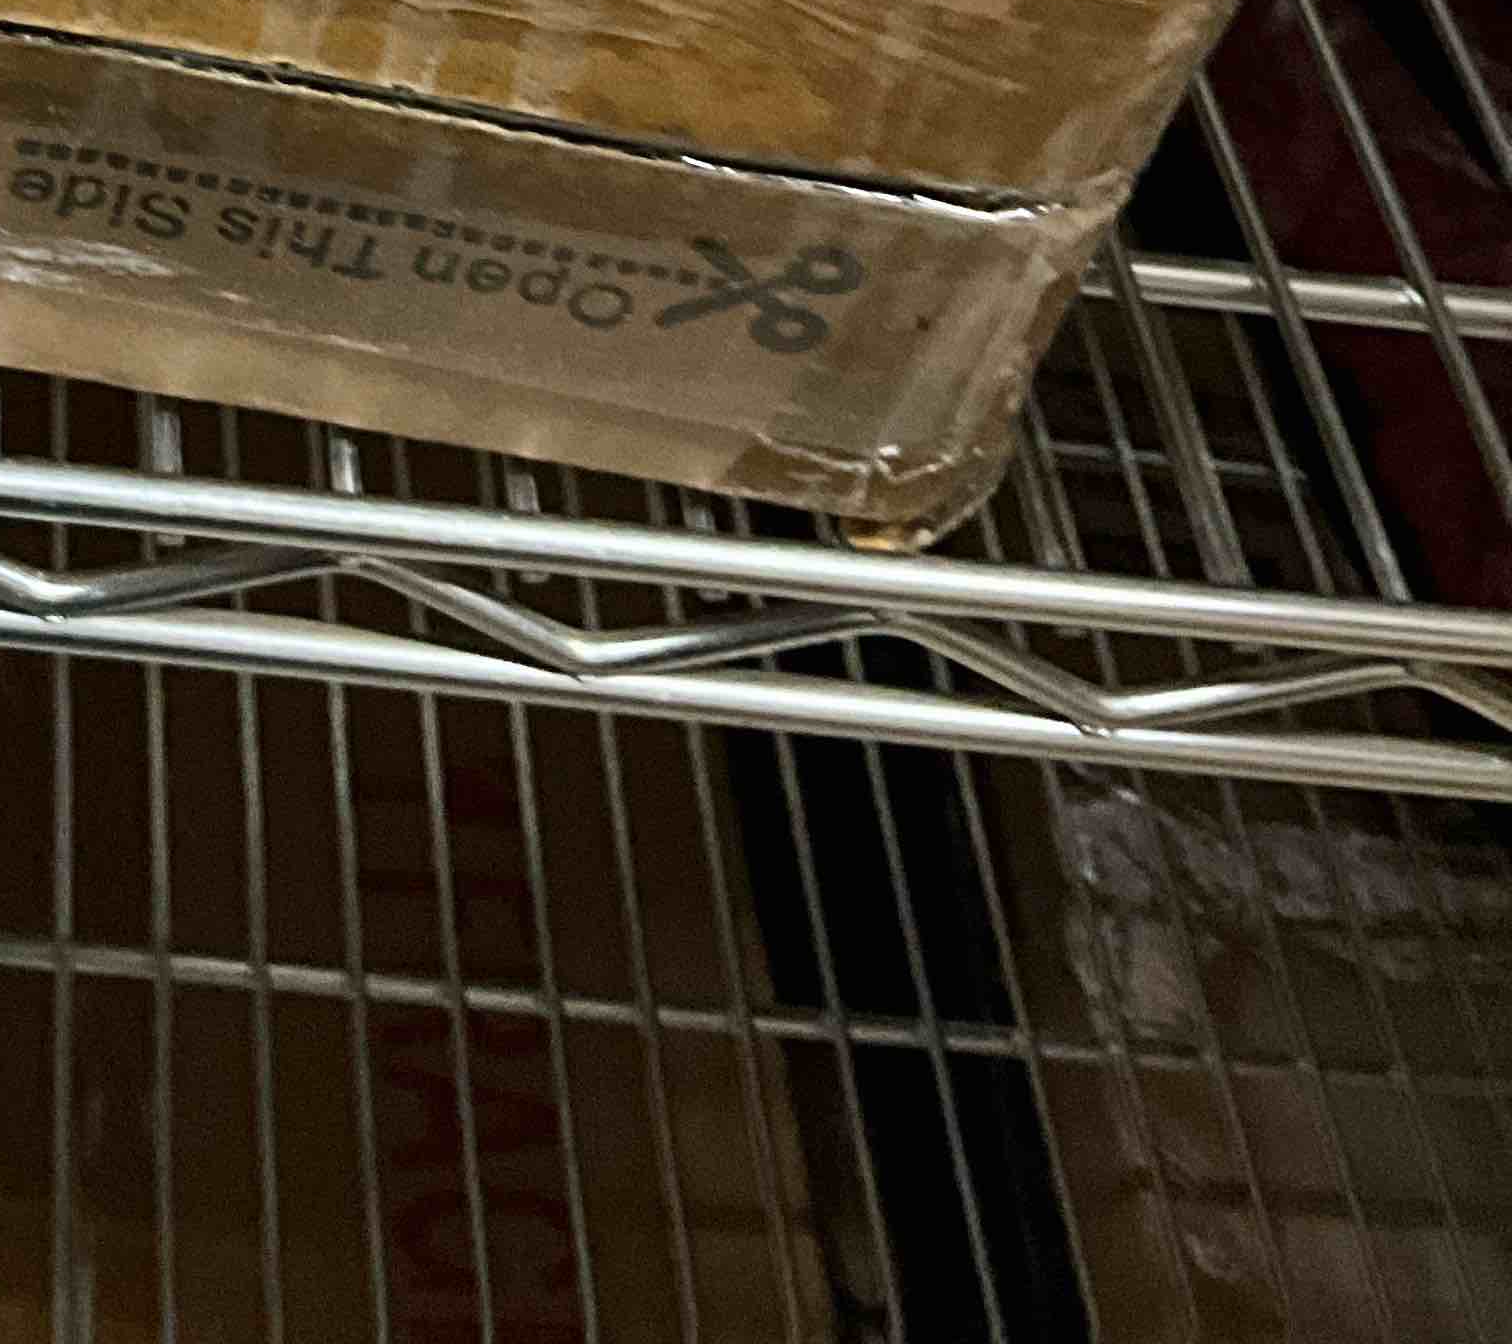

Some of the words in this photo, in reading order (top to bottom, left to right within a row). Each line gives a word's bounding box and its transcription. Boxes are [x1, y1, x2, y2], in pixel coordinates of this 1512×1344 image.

[7, 164, 192, 243] Side
[215, 204, 386, 282] This
[411, 230, 635, 331] Open
